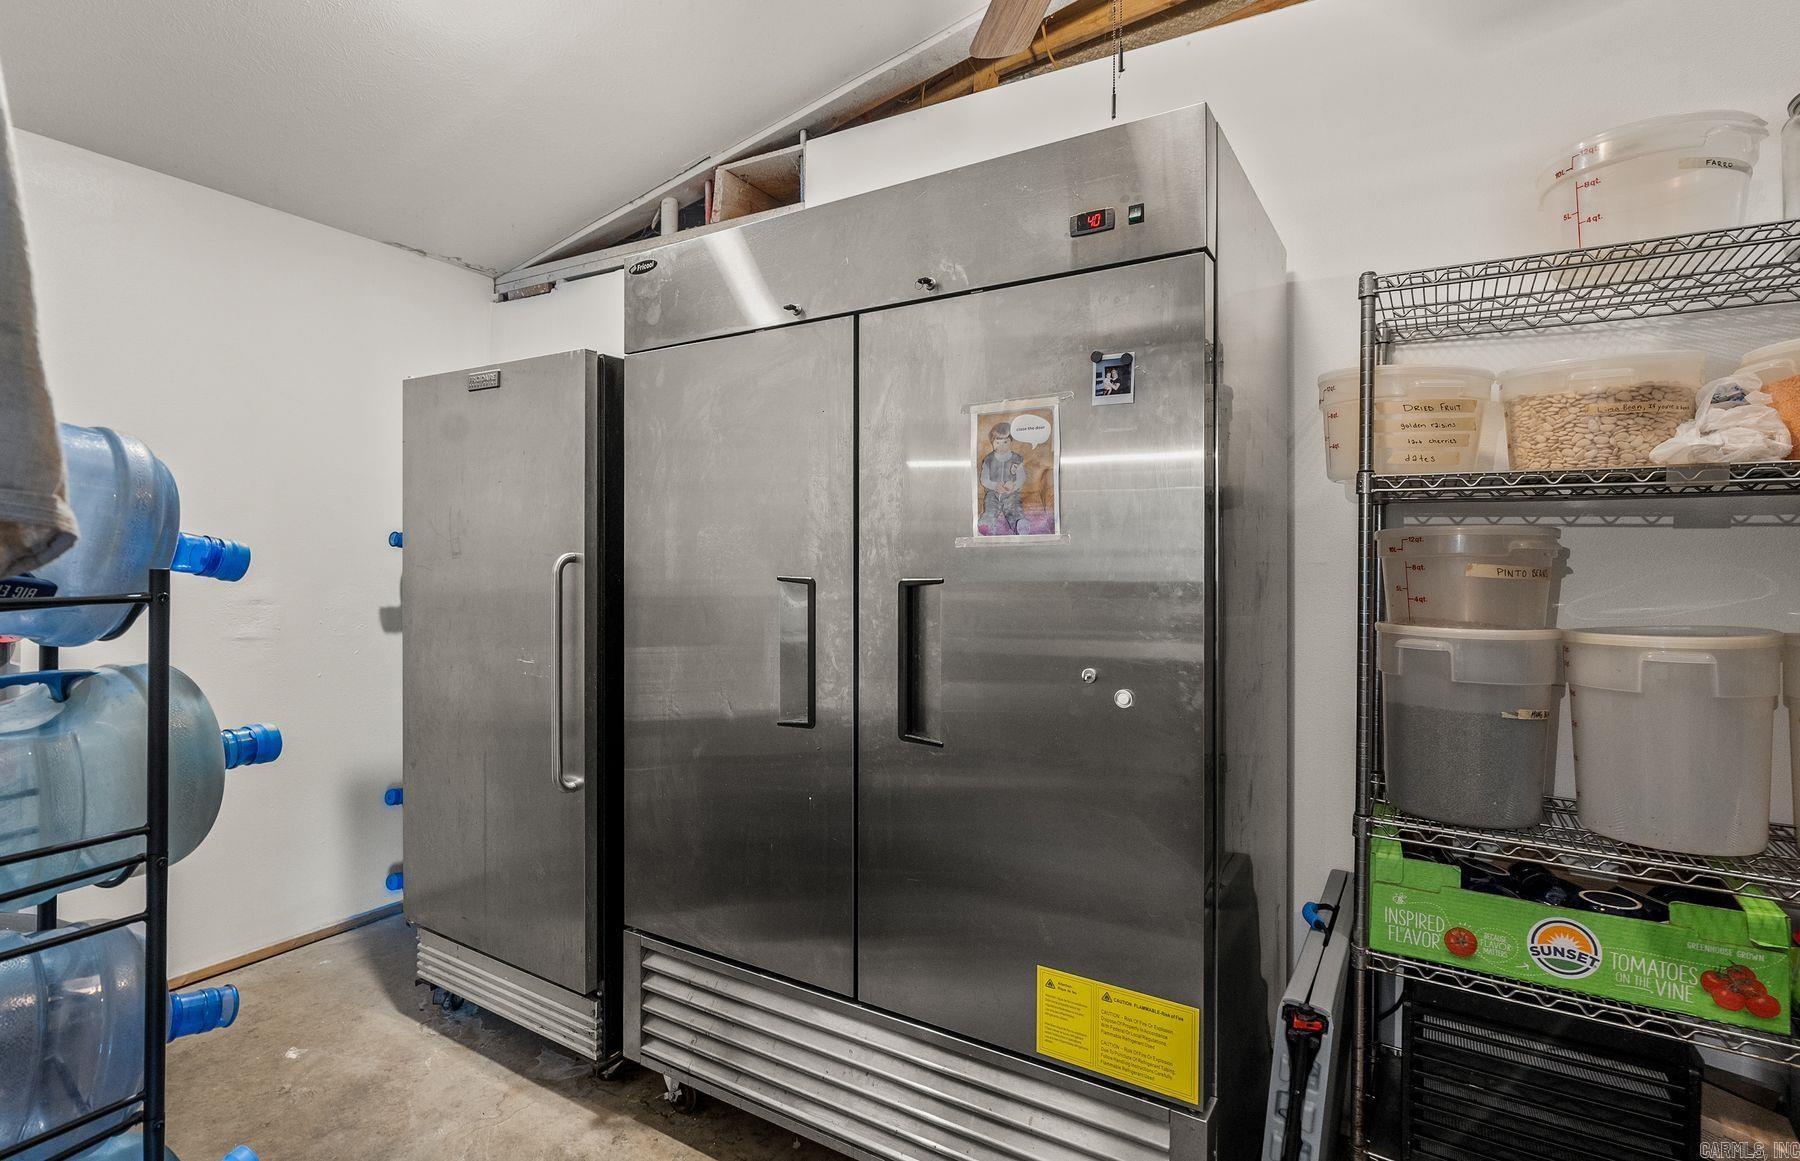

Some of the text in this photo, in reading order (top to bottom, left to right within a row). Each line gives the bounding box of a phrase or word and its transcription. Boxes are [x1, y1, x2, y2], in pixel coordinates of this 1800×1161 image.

[1705, 159, 1733, 168] FARRO
[1584, 178, 1601, 189] 8qt.
[1087, 213, 1101, 227] 40
[1563, 213, 1572, 221] 5L
[1586, 213, 1603, 223] 4qt.
[1403, 402, 1461, 412] DRIED FRUIT
[1400, 422, 1426, 430] golden
[1405, 454, 1436, 462] dates
[1496, 568, 1528, 578] PINTO
[1384, 906, 1445, 933] INSPIRED
[1388, 925, 1440, 950] FLAVOR
[1480, 940, 1512, 952] FLAVOR
[1530, 946, 1600, 968] SUNSET
[1687, 942, 1765, 962] GREENHOUSE GROWN
[1610, 951, 1698, 986] TOMATOES
[1615, 972, 1694, 1004] ON THE VINE
